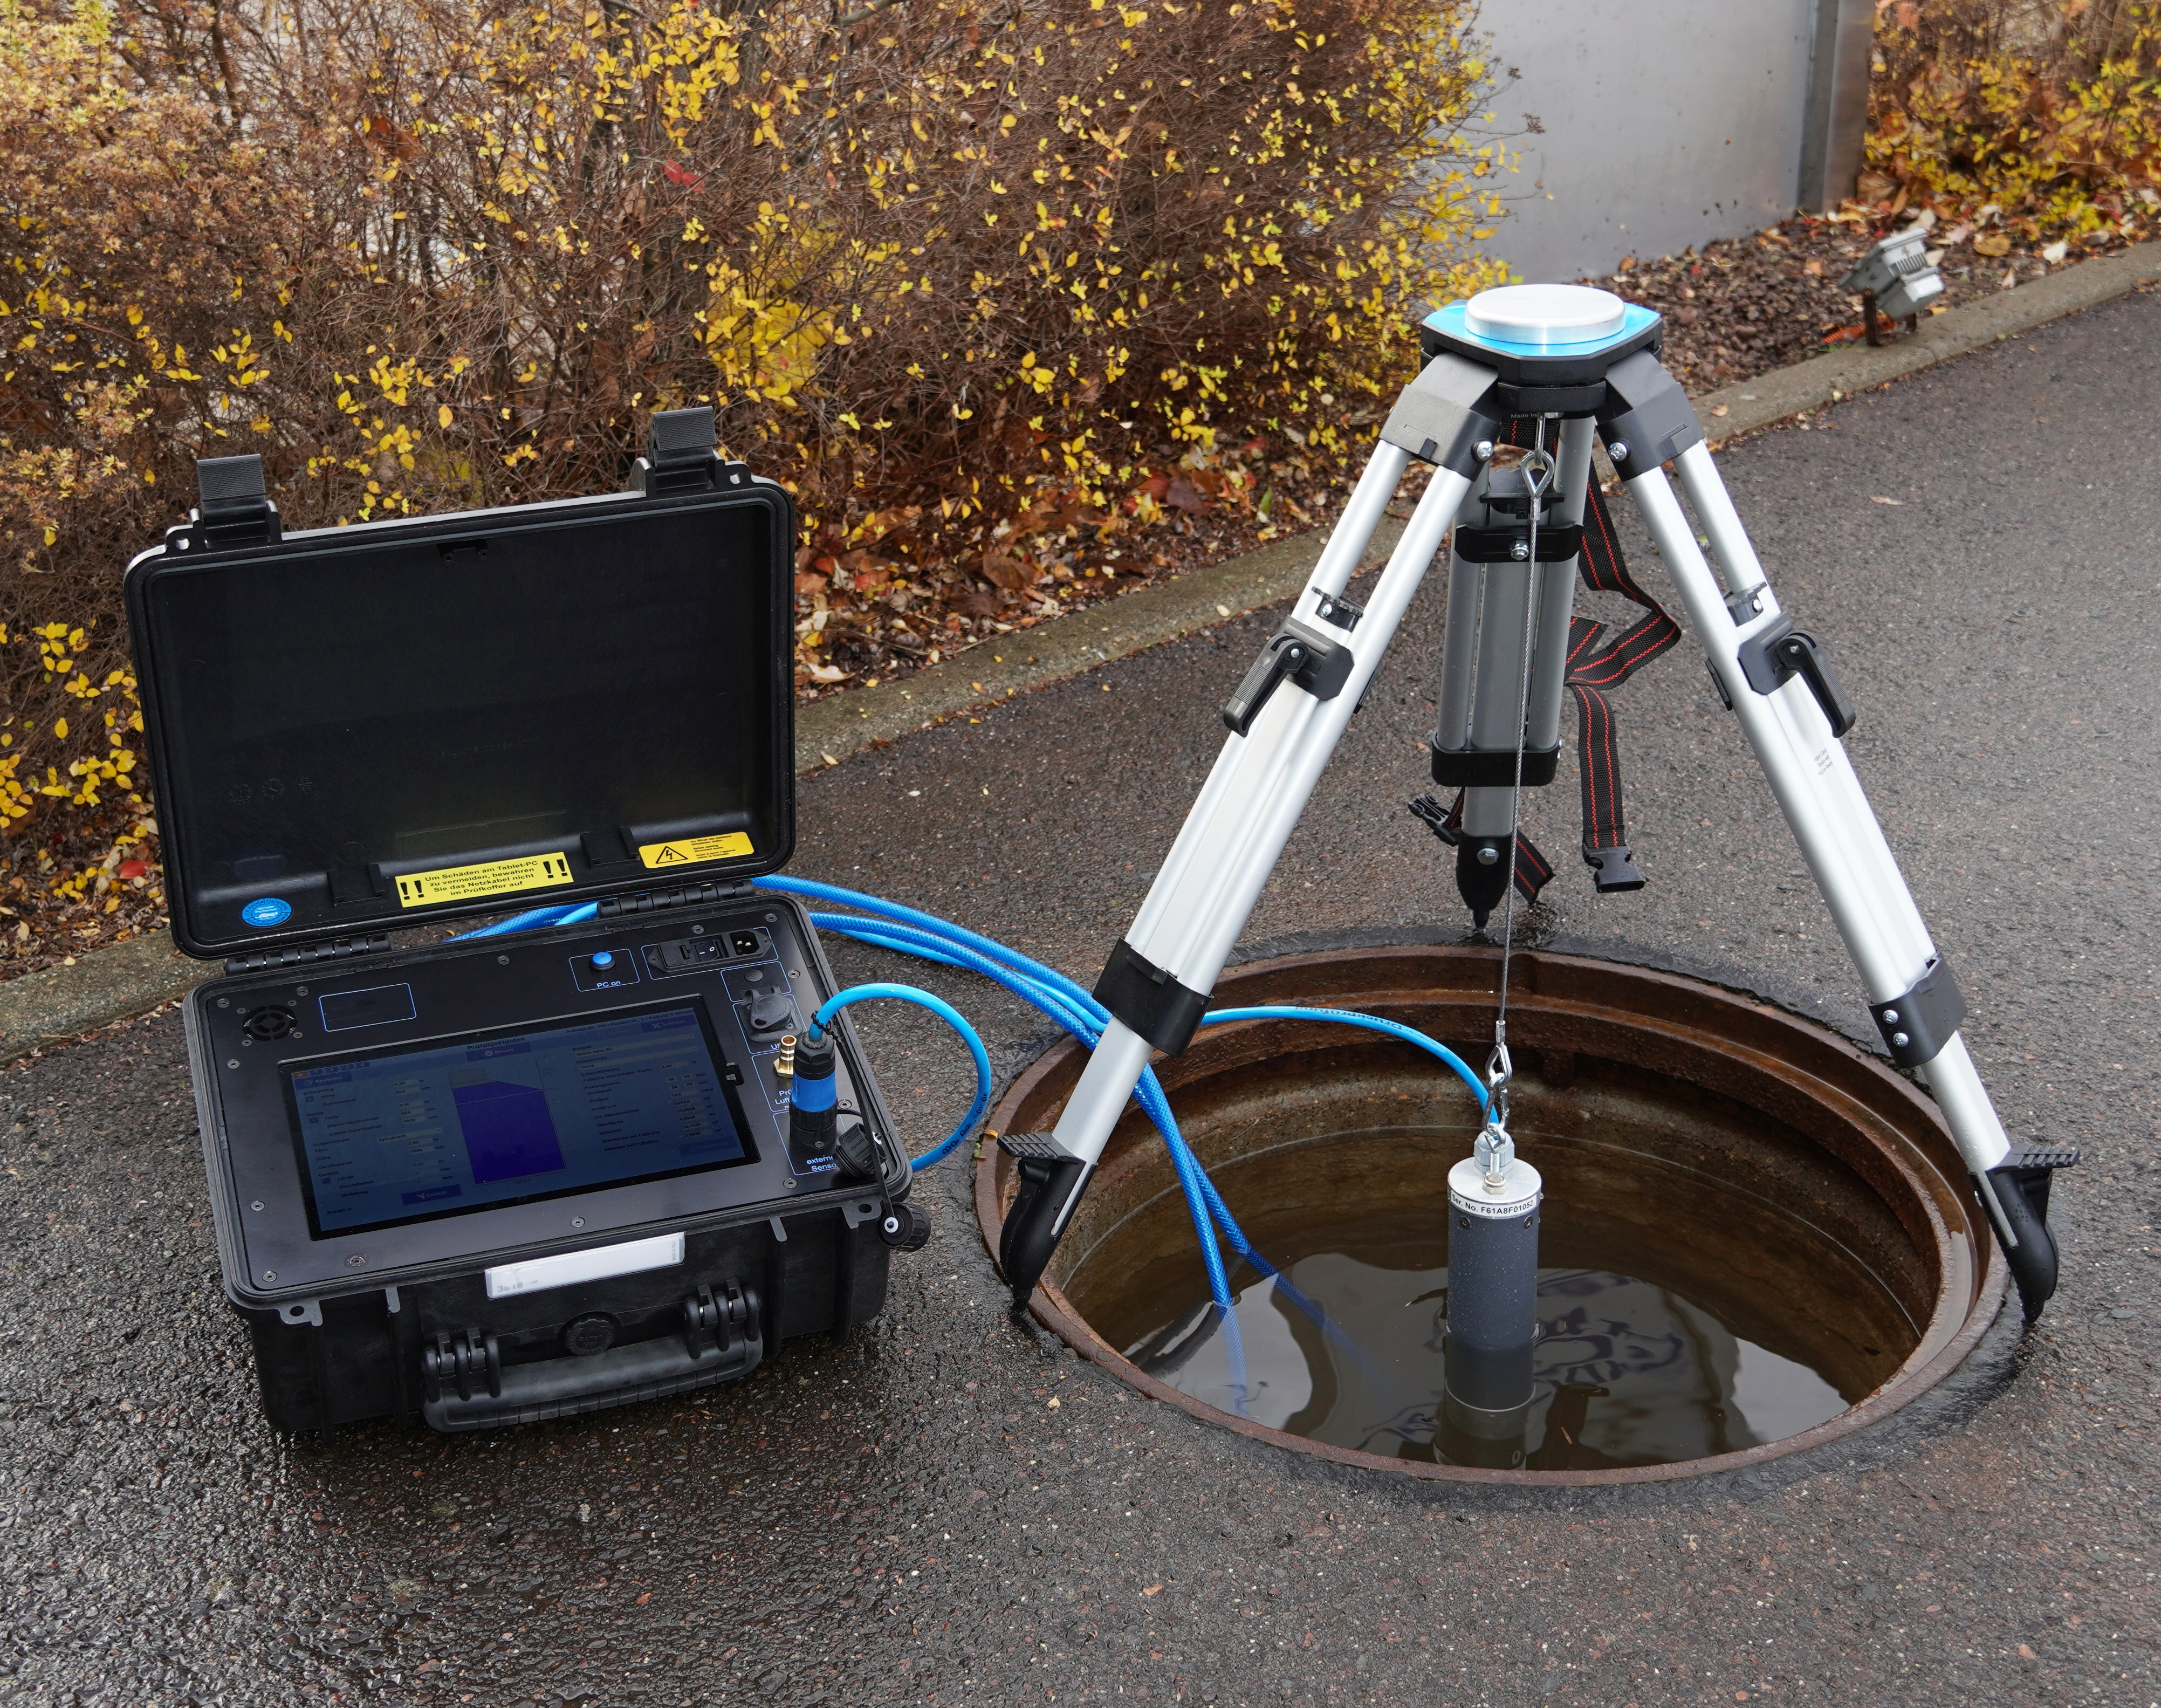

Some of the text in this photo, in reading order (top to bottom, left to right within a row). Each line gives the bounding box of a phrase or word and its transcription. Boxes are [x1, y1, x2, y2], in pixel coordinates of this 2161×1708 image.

[442, 870, 479, 879] Schäden
[497, 861, 538, 871] Tablet-PC
[442, 875, 490, 885] vermeiden,
[492, 867, 534, 877] bewahren
[468, 877, 510, 887] Netzkabel
[512, 873, 534, 881] nicht
[464, 883, 507, 894] Prüfkoffer
[467, 1037, 526, 1051] Prüfobjektdaten
[323, 1097, 358, 1107] Durchmesser
[345, 1116, 380, 1126] Durchmesser
[347, 1123, 383, 1133] Durchmesser
[378, 1134, 407, 1142] Zylindrisch
[601, 1135, 629, 1144] Oberfläche
[318, 1160, 353, 1169] Durchmesser
[811, 1163, 837, 1171] Senso
[339, 1179, 375, 1189] Durchmesser
[1452, 1193, 1534, 1214] Ser. No. F61A8F01052
